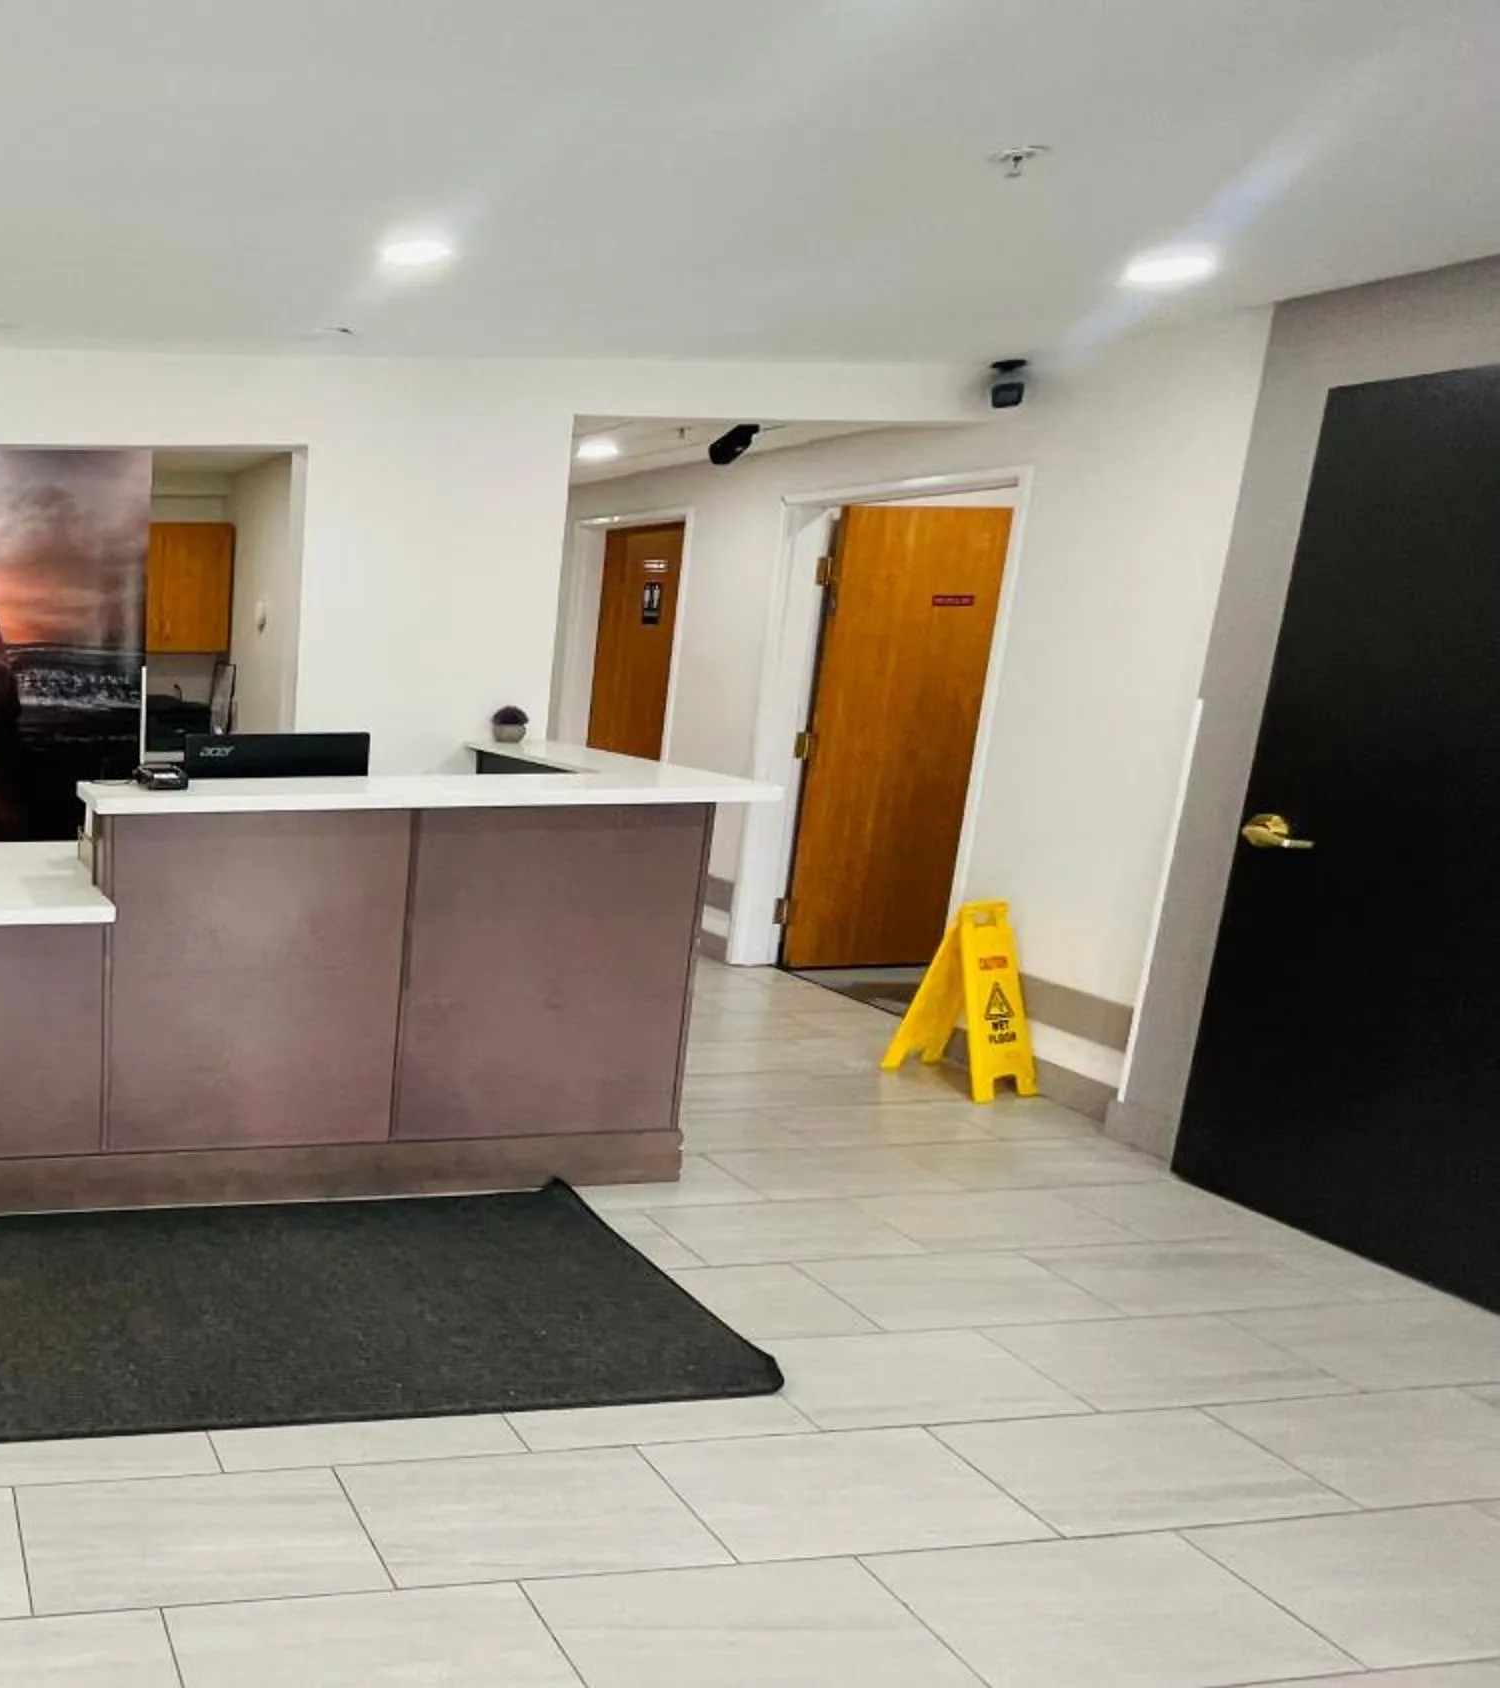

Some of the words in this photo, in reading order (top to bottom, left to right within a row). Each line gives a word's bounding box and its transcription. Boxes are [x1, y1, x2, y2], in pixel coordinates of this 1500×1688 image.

[198, 745, 236, 757] acer
[991, 1019, 1009, 1031] WET
[988, 1032, 1017, 1045] FLOOR
